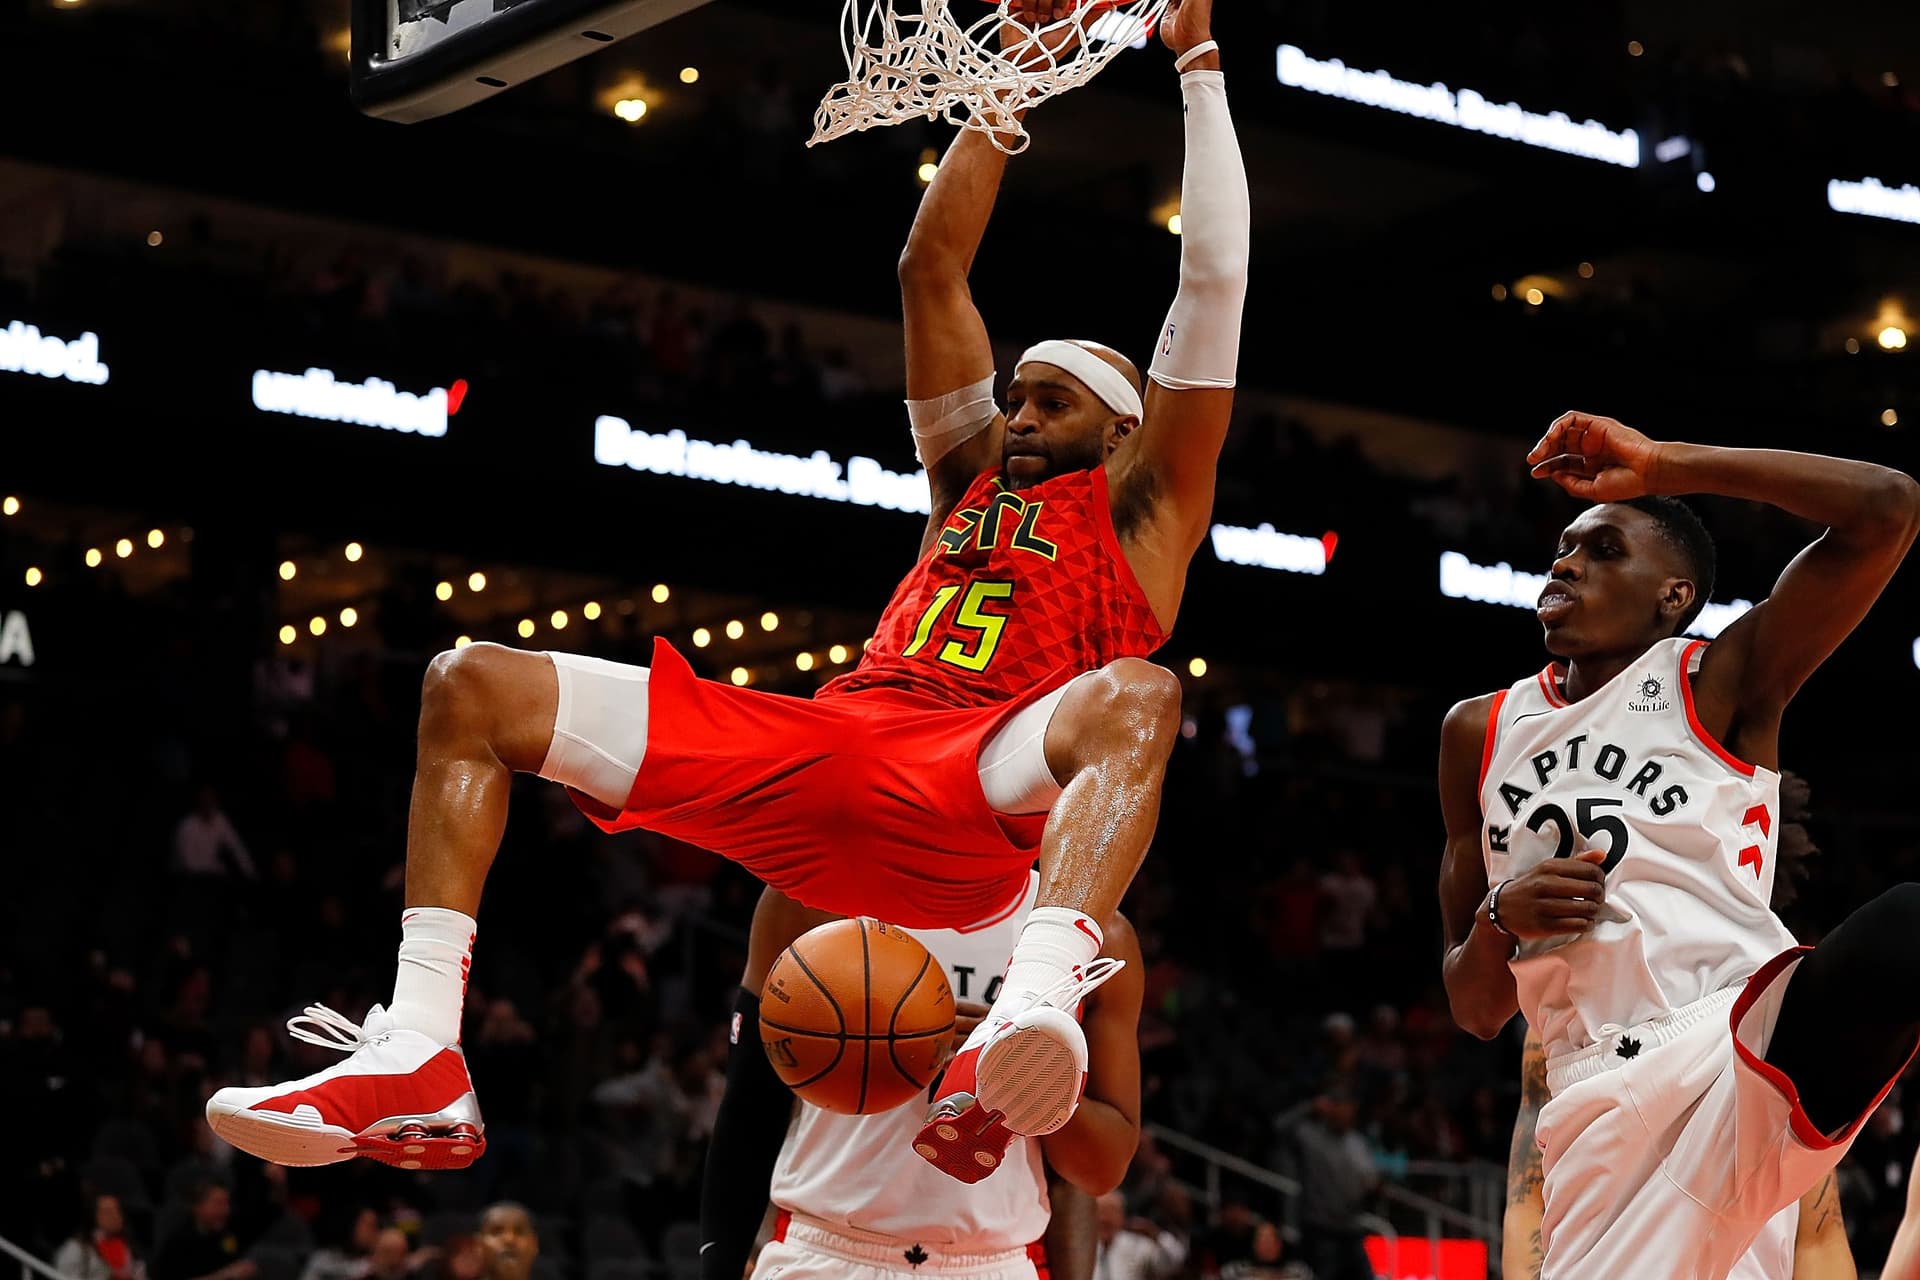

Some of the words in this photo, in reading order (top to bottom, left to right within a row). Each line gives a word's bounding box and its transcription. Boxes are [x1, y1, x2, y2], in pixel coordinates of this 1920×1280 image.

[901, 579, 1015, 672] 15
[1627, 701, 1650, 713] Sun
[1652, 700, 1670, 712] Life
[1488, 733, 1690, 854] RAPTORS
